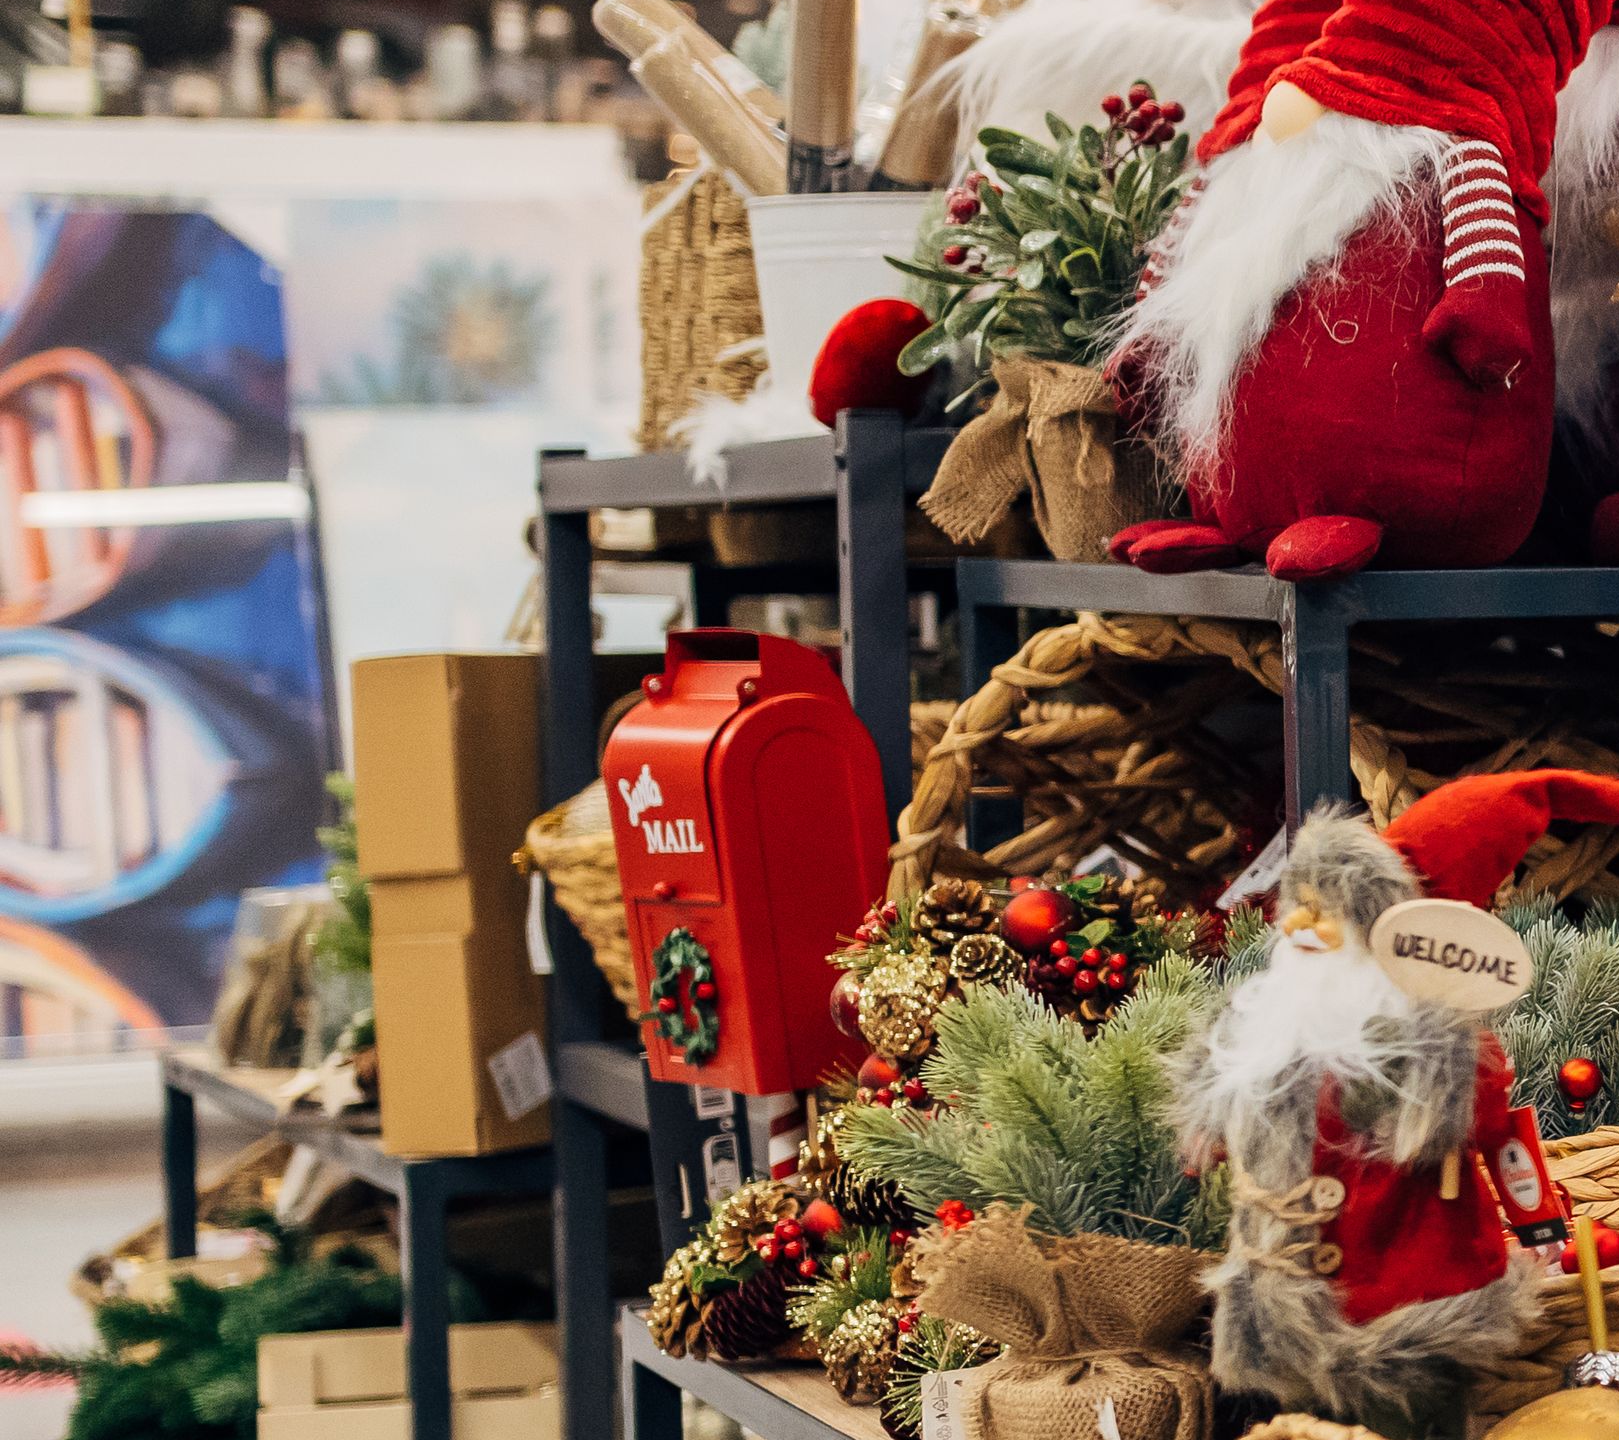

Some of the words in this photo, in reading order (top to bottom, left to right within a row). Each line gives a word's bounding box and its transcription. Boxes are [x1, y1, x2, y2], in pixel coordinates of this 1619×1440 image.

[618, 763, 664, 827] Santa
[641, 818, 705, 854] MAIL
[1393, 932, 1518, 987] WELCOME
